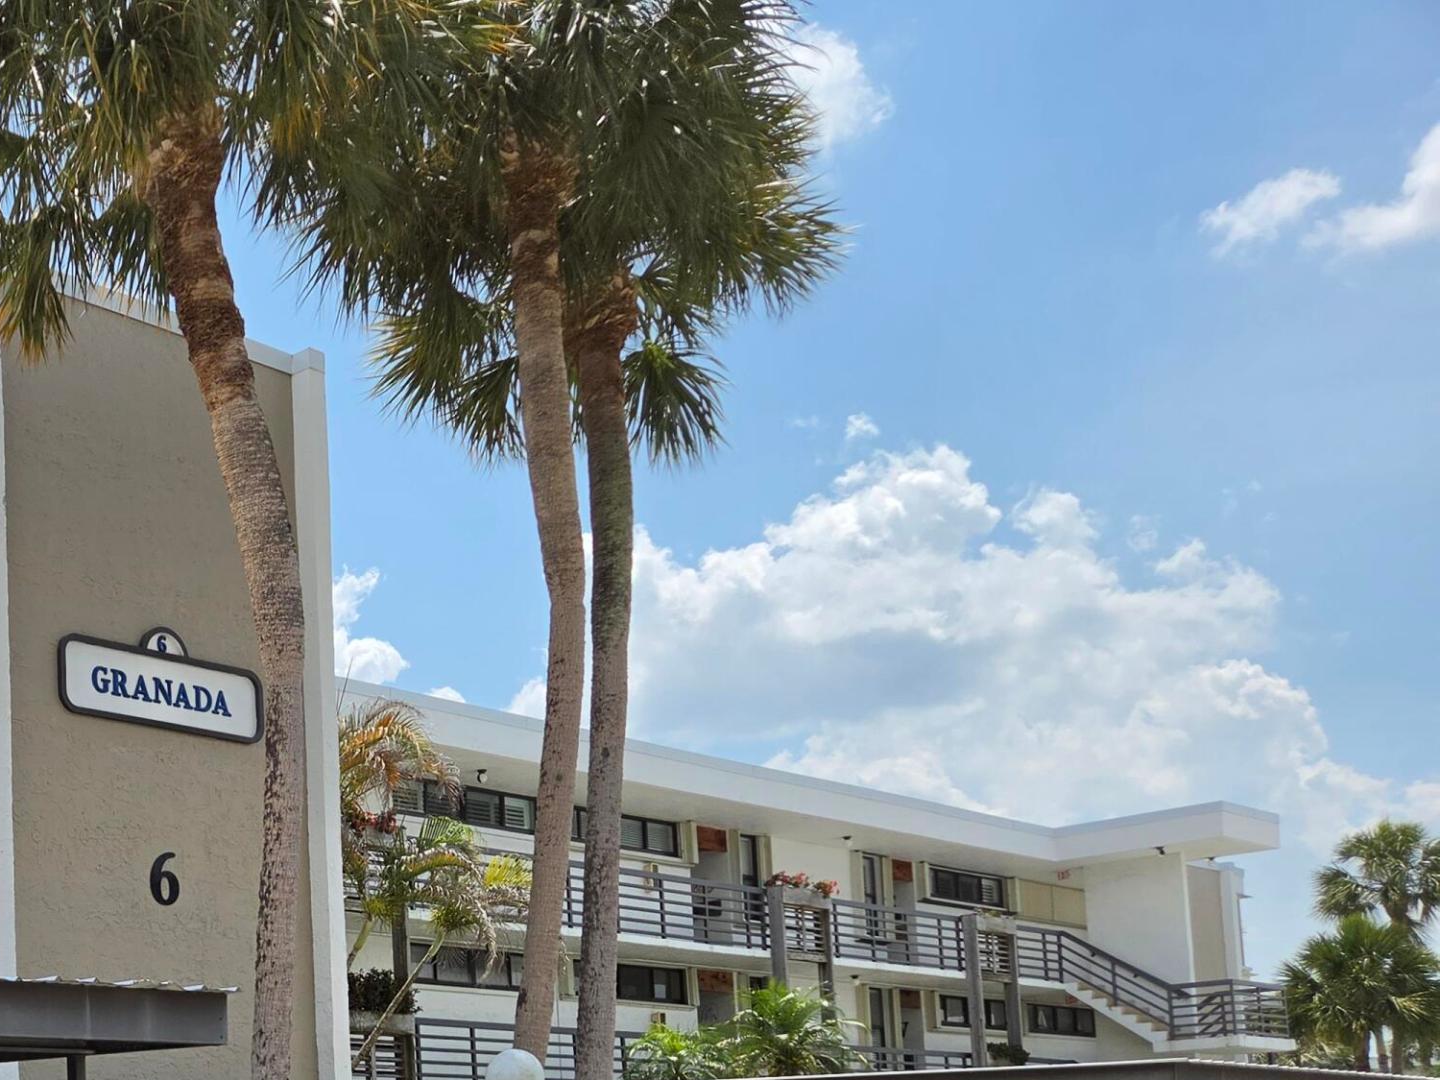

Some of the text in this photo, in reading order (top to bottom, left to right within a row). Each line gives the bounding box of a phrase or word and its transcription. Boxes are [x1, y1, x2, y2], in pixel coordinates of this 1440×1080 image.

[156, 635, 167, 653] 6
[91, 666, 231, 717] GRANADA
[149, 852, 180, 906] 6
